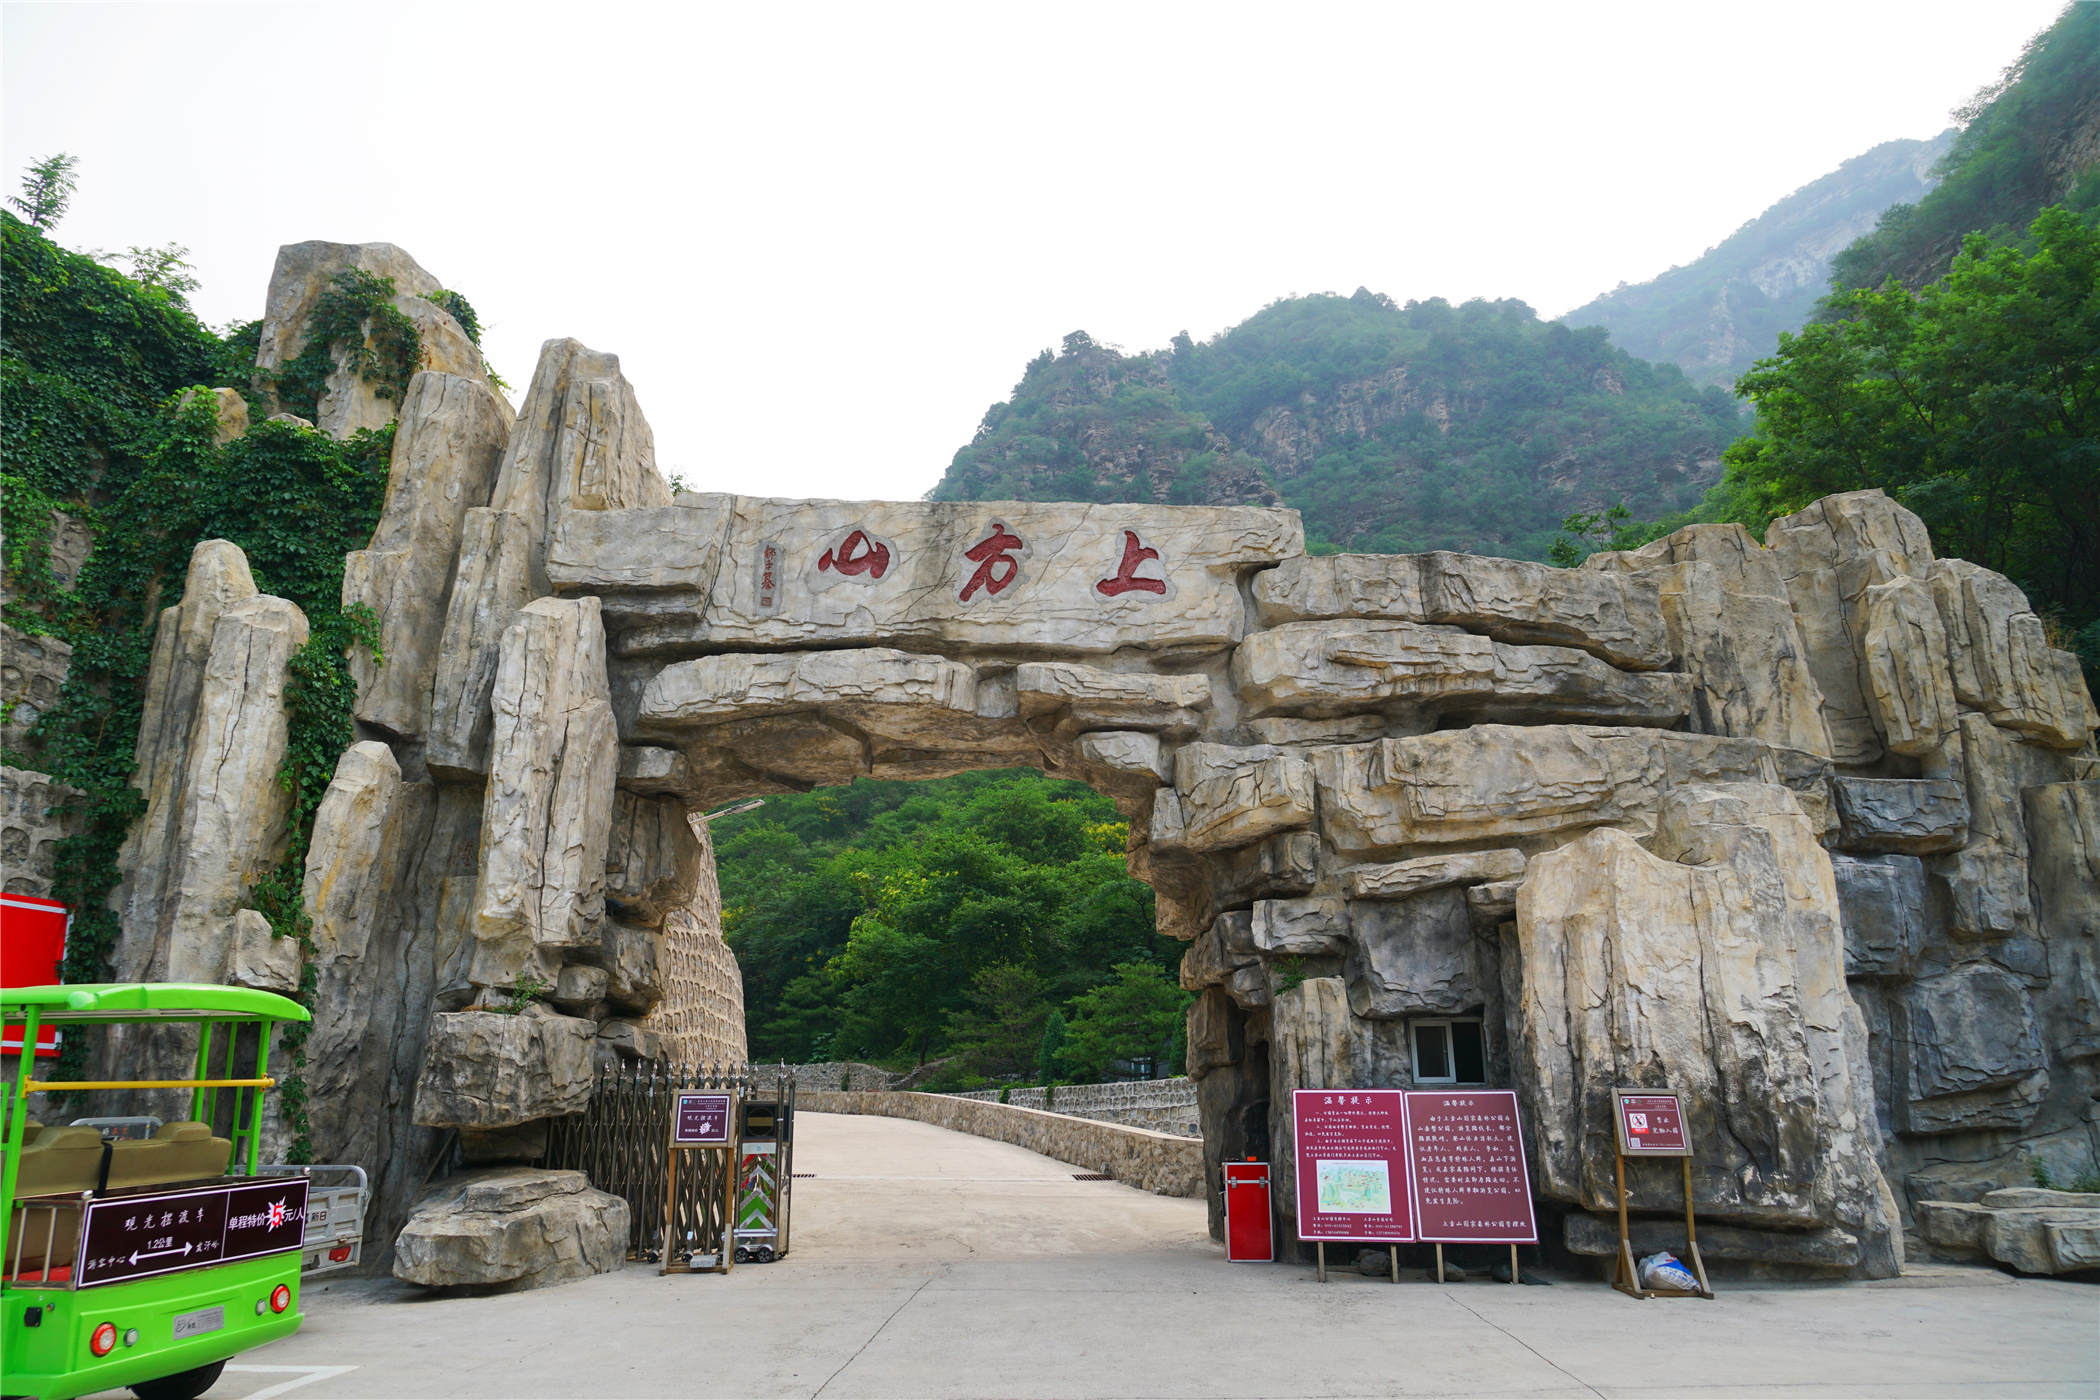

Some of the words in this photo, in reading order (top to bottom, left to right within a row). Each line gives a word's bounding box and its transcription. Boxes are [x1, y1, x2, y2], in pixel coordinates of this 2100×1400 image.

[1324, 1095, 1373, 1105] 温馨提示
[1442, 1099, 1475, 1107] 温馨提示
[124, 1207, 205, 1232] 观光摆渡车
[306, 1211, 327, 1225] 新日
[87, 1255, 126, 1271] 游客中心
